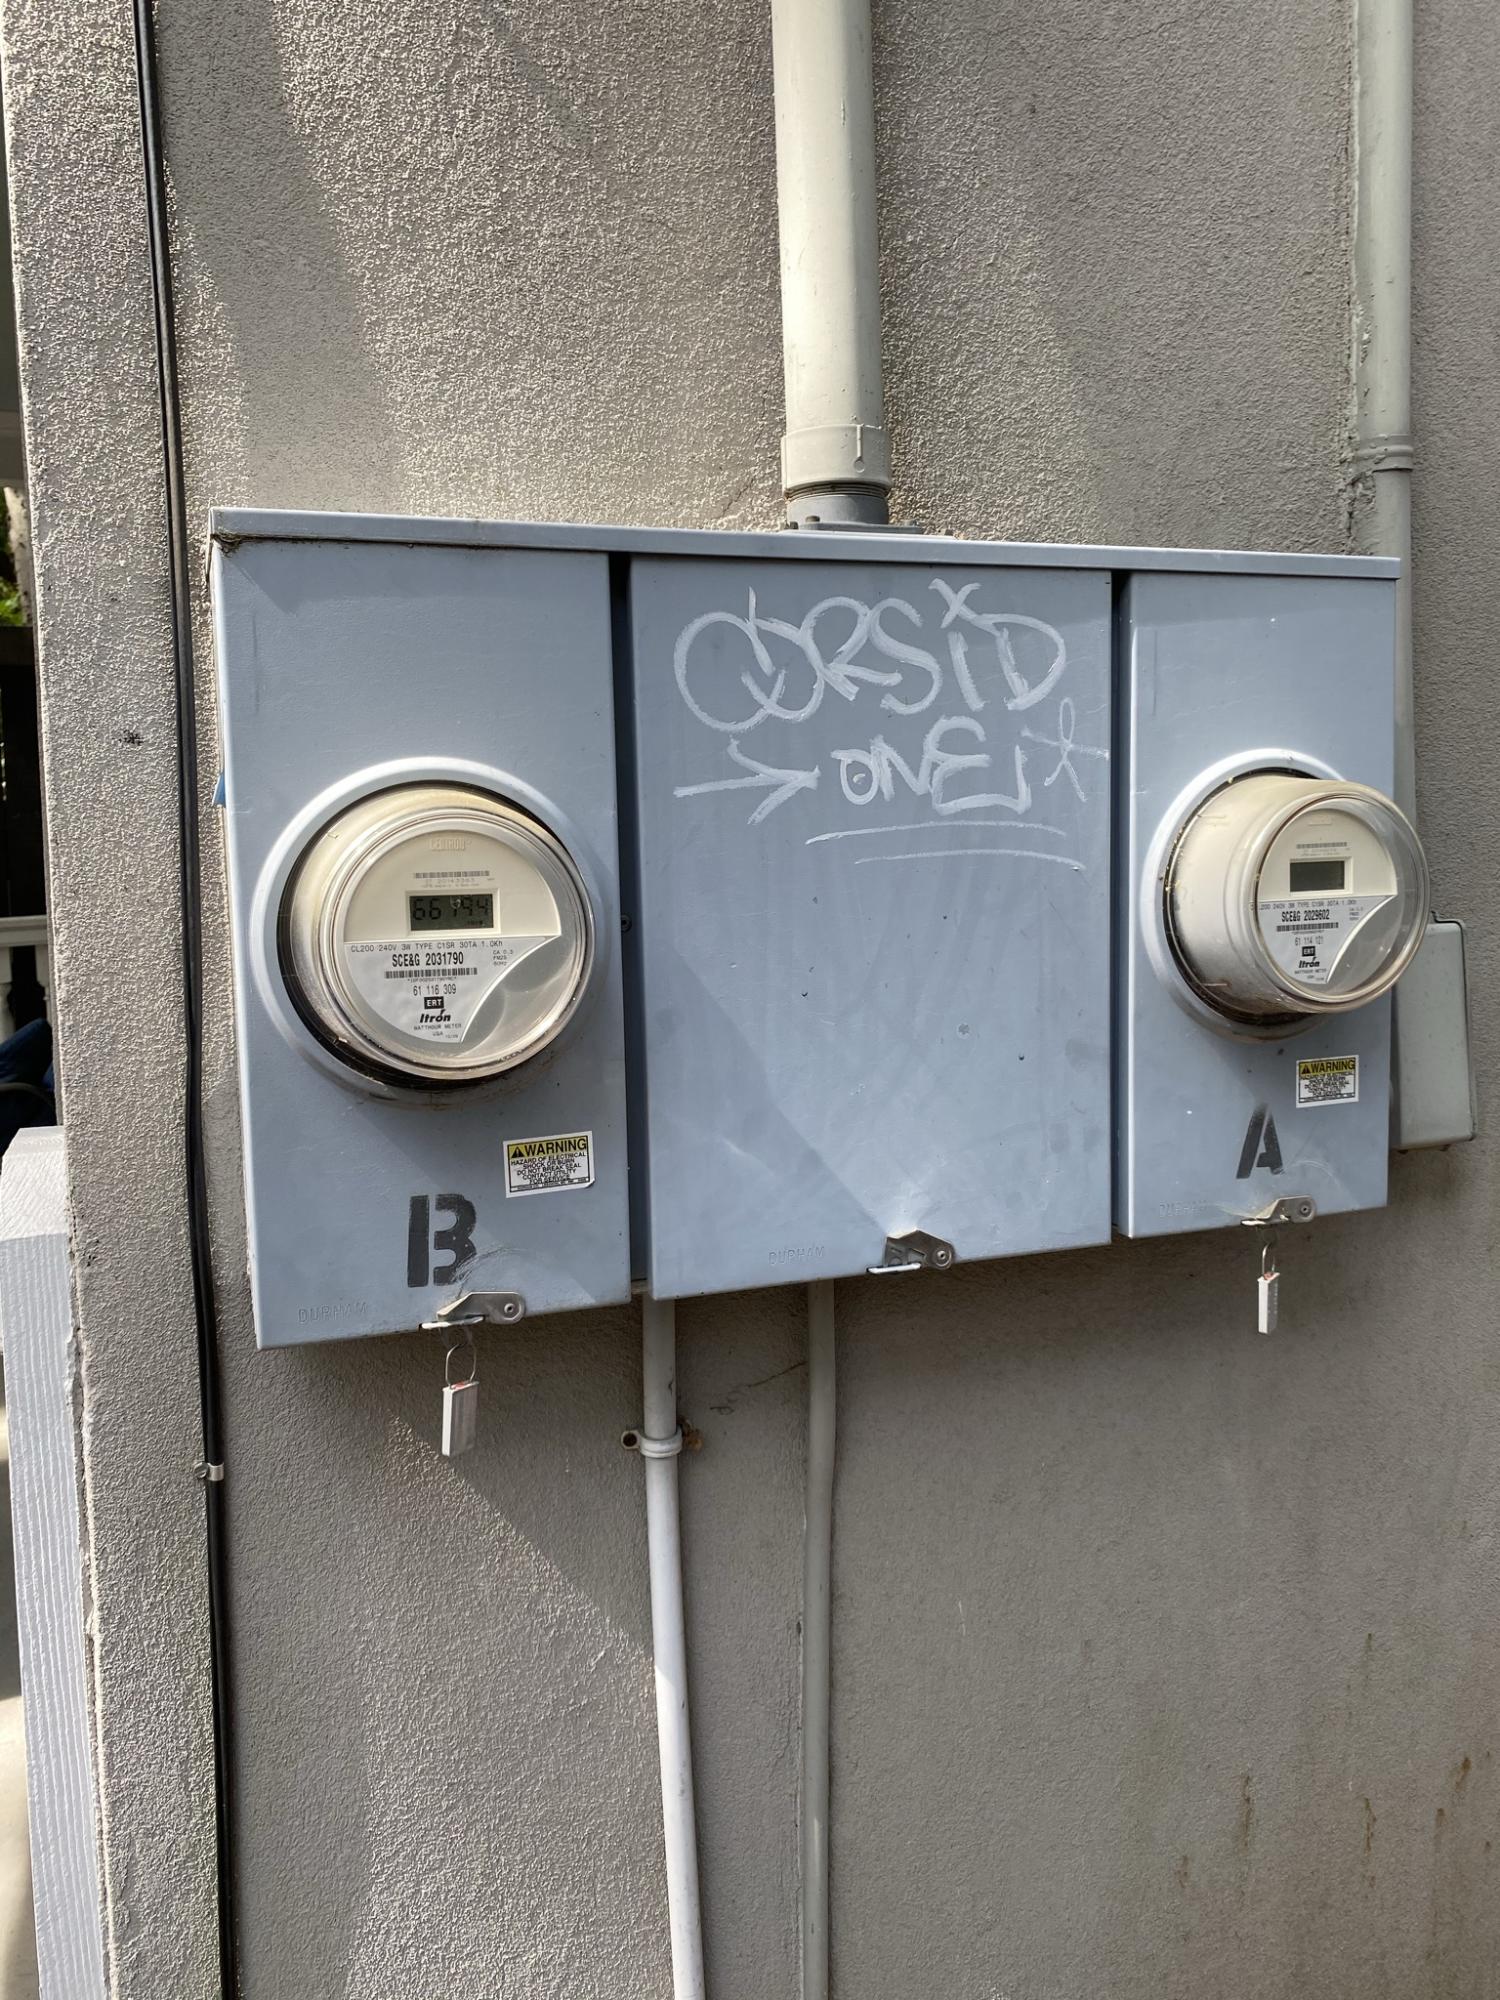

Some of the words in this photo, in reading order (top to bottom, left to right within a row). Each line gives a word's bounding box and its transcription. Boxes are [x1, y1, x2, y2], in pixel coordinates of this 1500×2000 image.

[1281, 910, 1301, 922] SCE&G
[378, 944, 397, 952] 240V
[415, 942, 432, 950] TYPE
[392, 953, 420, 967] SCE&G
[425, 951, 464, 966] 2031790
[413, 985, 421, 996] 61
[427, 984, 439, 995] 116
[443, 983, 456, 994] 309
[420, 1009, 451, 1023] Itron
[1311, 1059, 1355, 1073] WARNING
[524, 1138, 587, 1156] WARNING
[1236, 1102, 1284, 1179] A
[511, 1156, 536, 1165] HAZARD
[548, 1151, 586, 1160] ELECTRICAL
[523, 1161, 545, 1169] SHOCK
[523, 1171, 552, 1180] CONTACT
[407, 1193, 477, 1288] B
